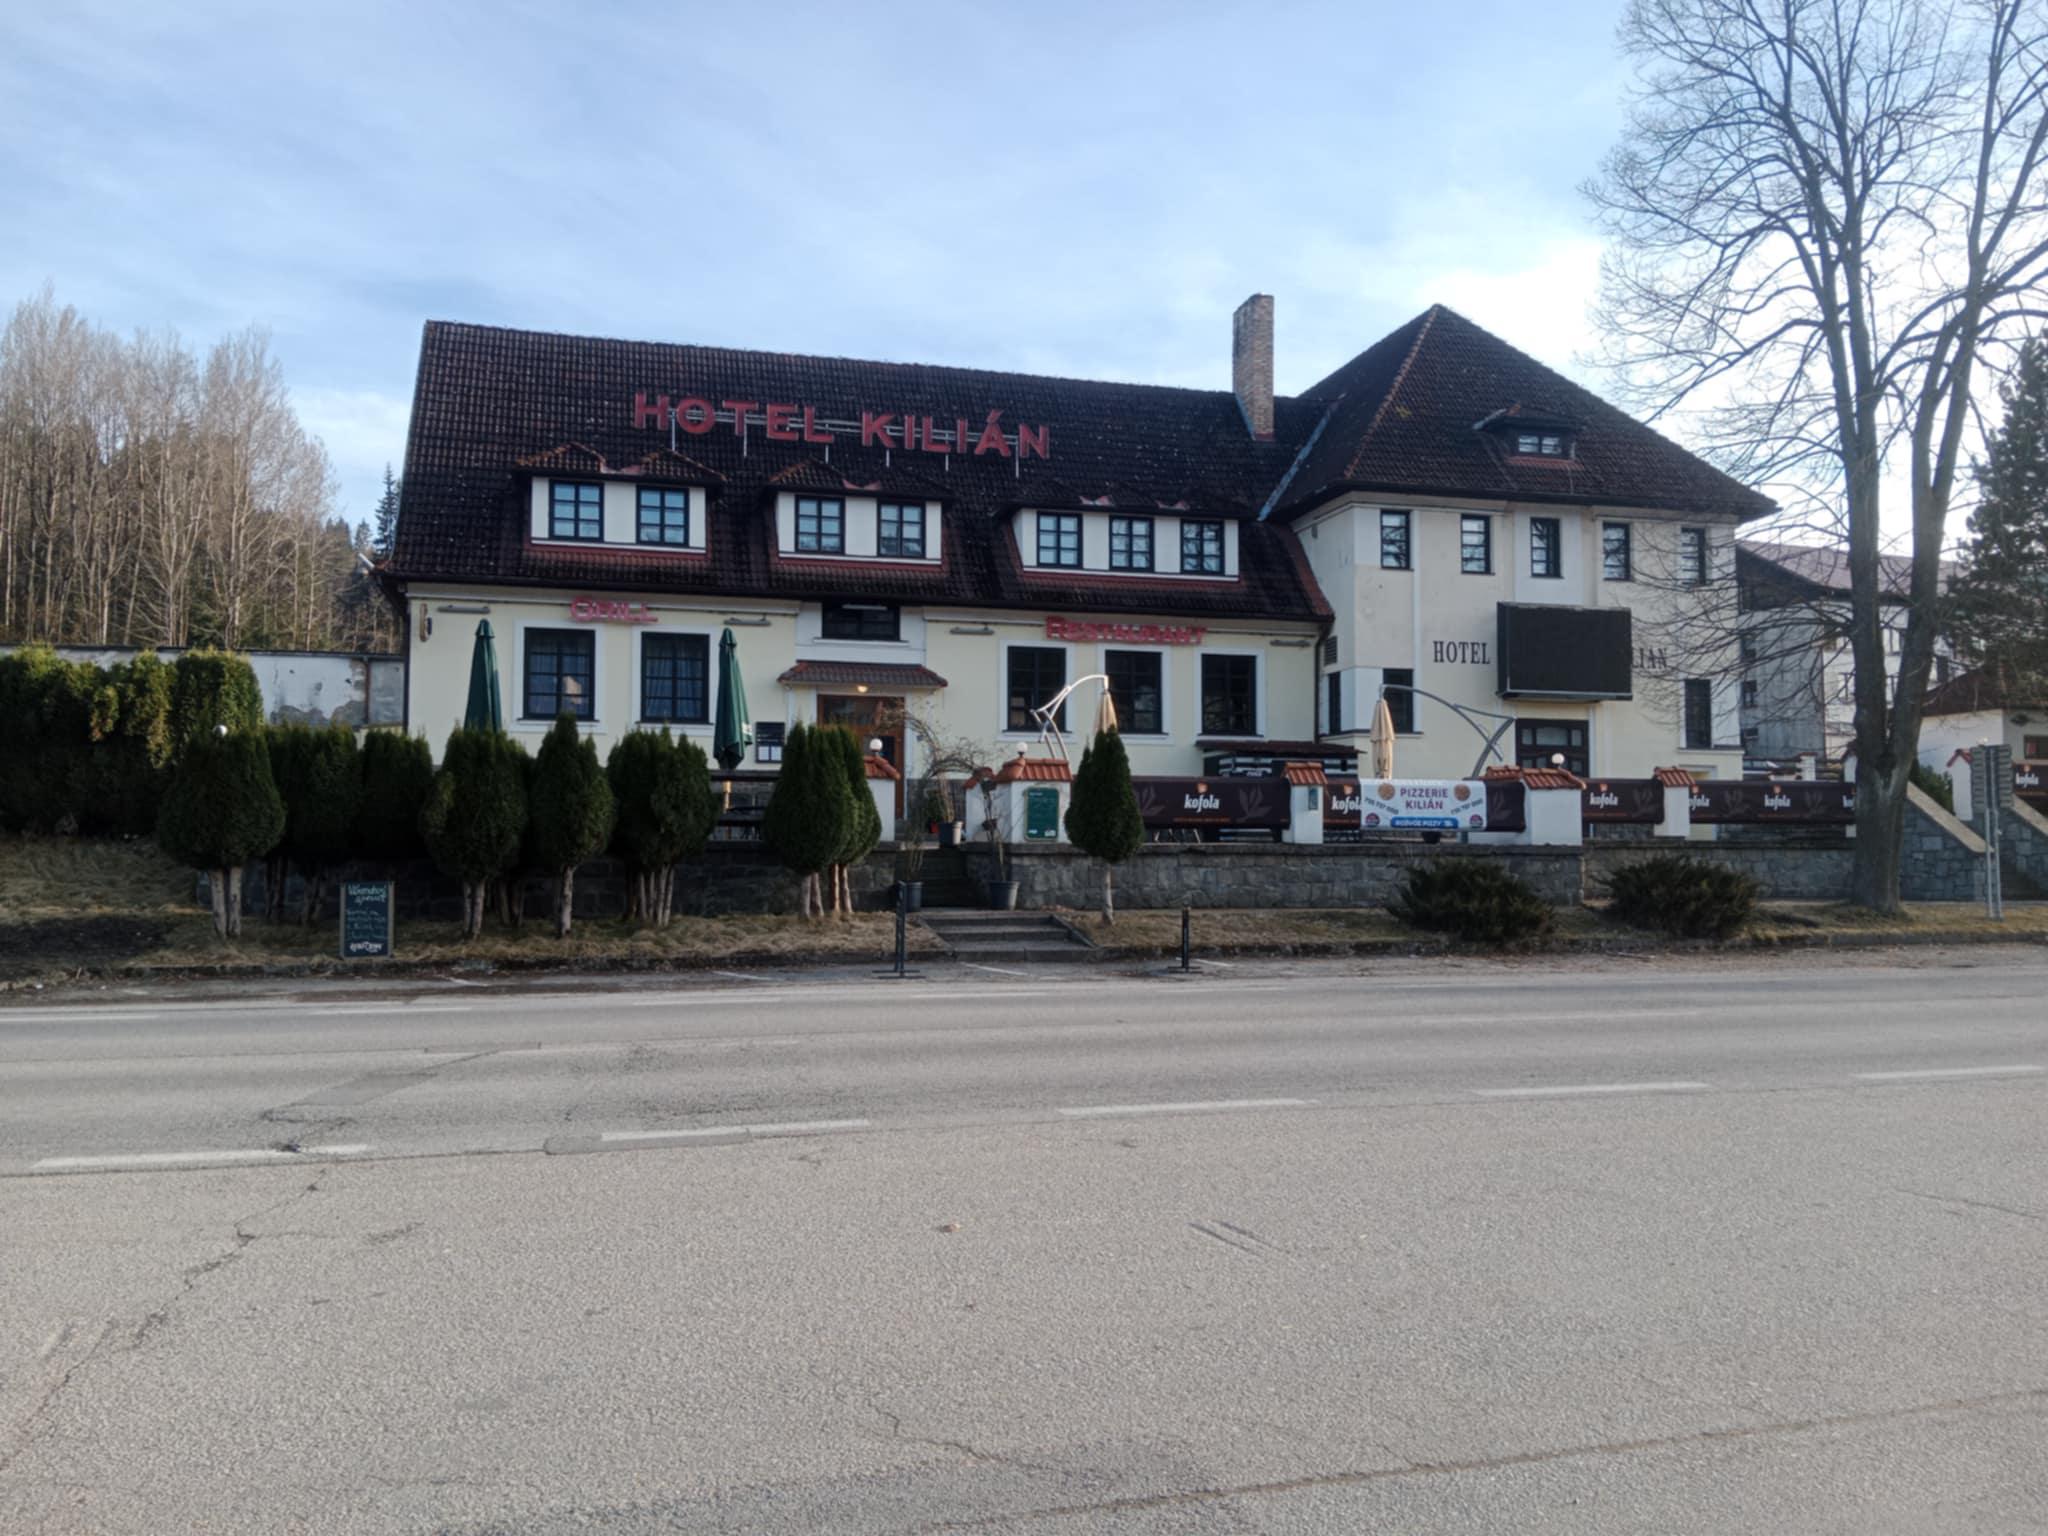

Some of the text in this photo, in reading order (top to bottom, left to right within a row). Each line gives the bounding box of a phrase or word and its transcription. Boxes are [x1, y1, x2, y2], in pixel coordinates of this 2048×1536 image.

[634, 392, 1049, 458] HOTEL KILIÁN
[1433, 640, 1491, 664] HOTEL
[1400, 787, 1449, 799] PIZZERIE
[1589, 792, 1618, 808] kofola
[1184, 793, 1220, 813] kofola
[1405, 798, 1444, 810] KILIÁN
[1763, 794, 1791, 811] kofola
